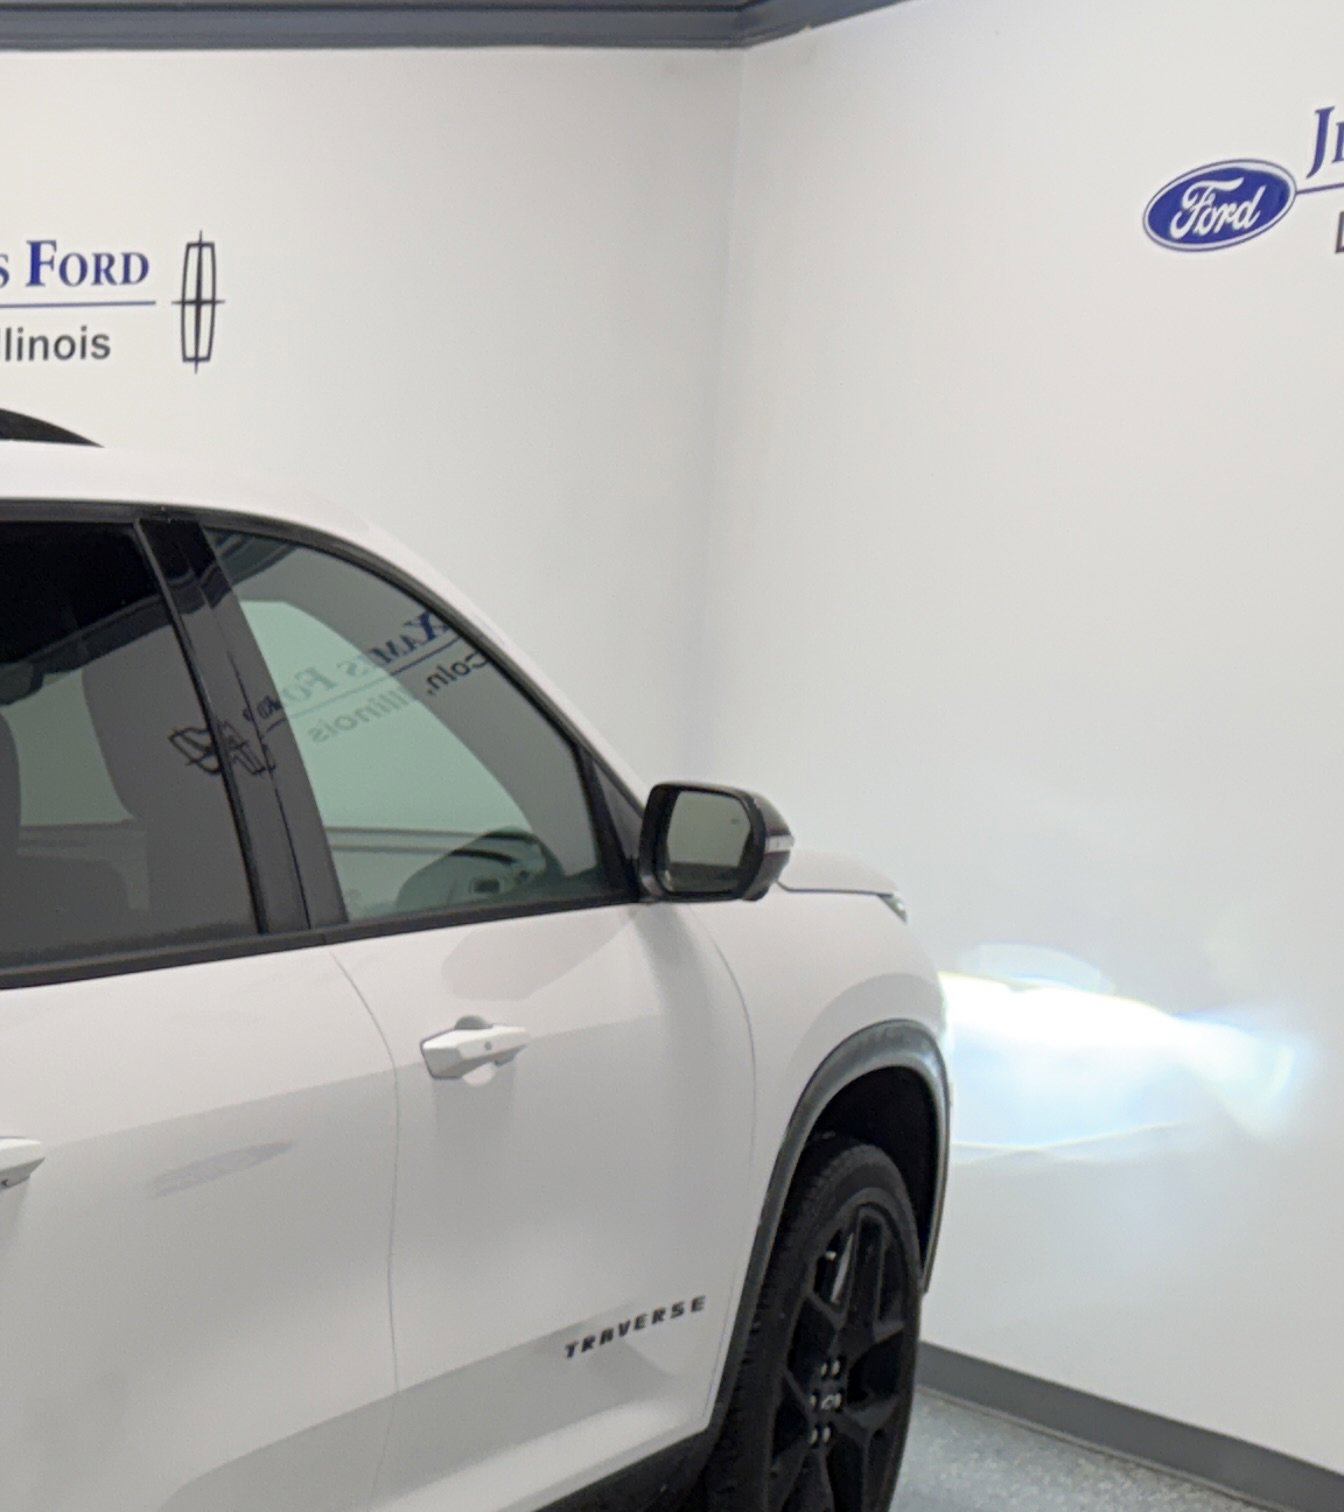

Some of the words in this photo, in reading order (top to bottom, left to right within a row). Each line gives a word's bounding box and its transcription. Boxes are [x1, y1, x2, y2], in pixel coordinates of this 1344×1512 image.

[1306, 106, 1344, 179] JI
[1170, 177, 1267, 240] Ford
[25, 239, 150, 288] FORD
[564, 1296, 705, 1359] TRAVERSE
